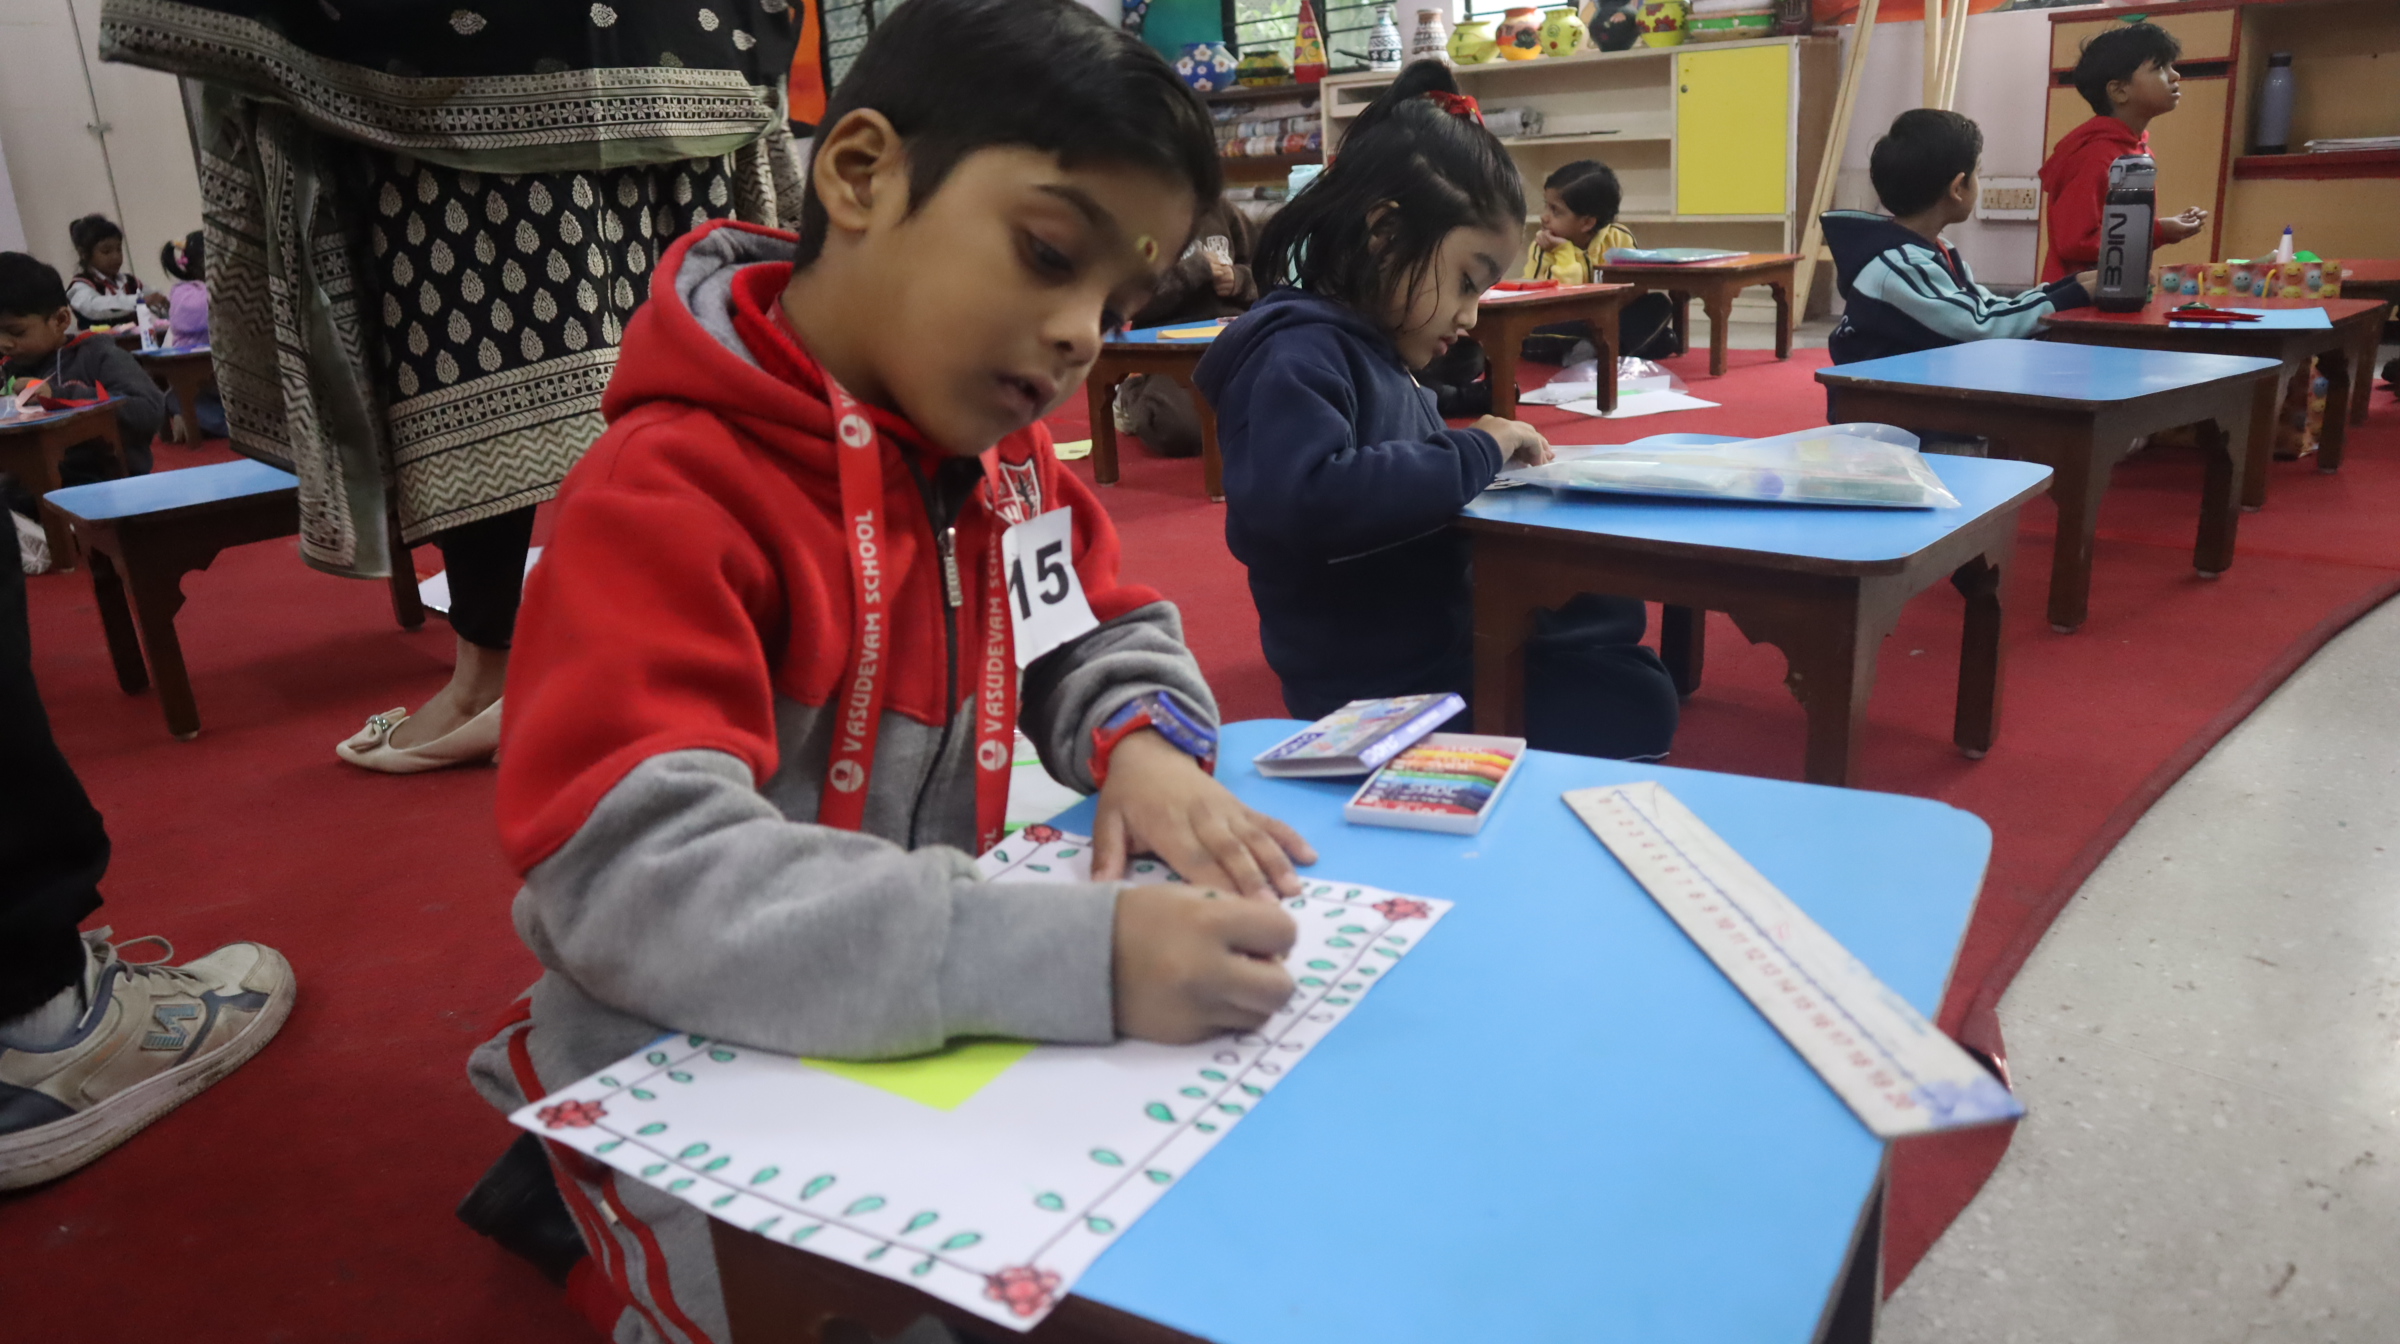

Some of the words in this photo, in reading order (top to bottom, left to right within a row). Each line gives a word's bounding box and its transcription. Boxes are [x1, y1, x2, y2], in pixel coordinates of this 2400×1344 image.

[2104, 212, 2127, 286] NICE
[855, 509, 882, 604] SCHOOL
[1009, 540, 1070, 621] 15
[842, 612, 881, 752] VASUDEVAM
[984, 597, 1005, 732] VASUDEVAM
